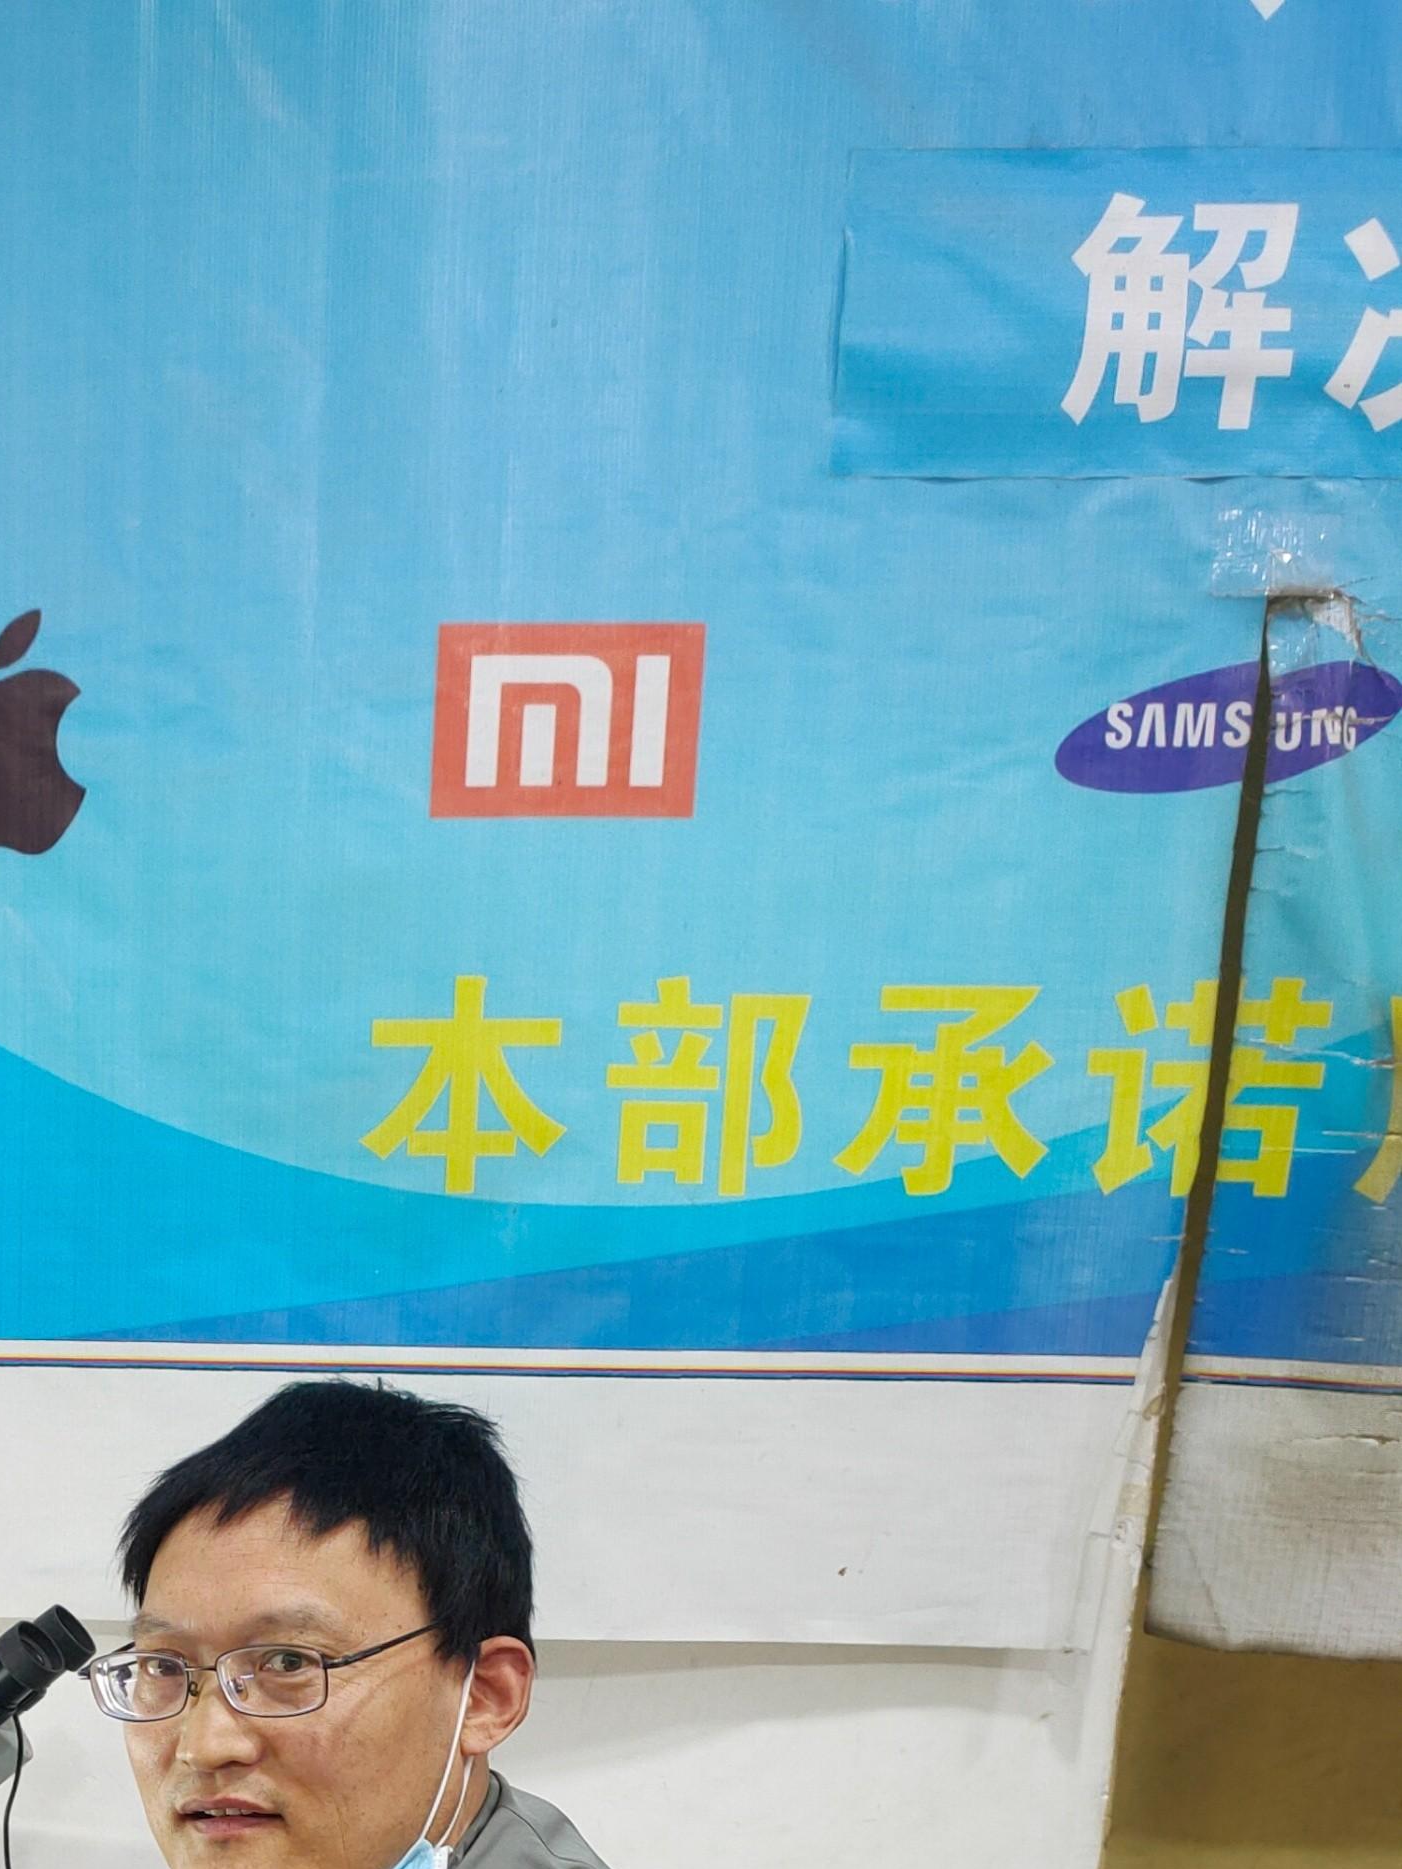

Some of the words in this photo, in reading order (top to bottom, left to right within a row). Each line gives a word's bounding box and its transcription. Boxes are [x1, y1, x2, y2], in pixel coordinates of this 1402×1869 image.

[1104, 700, 1358, 752] SAMSUNG
[360, 974, 1402, 1203] 本部承诺
